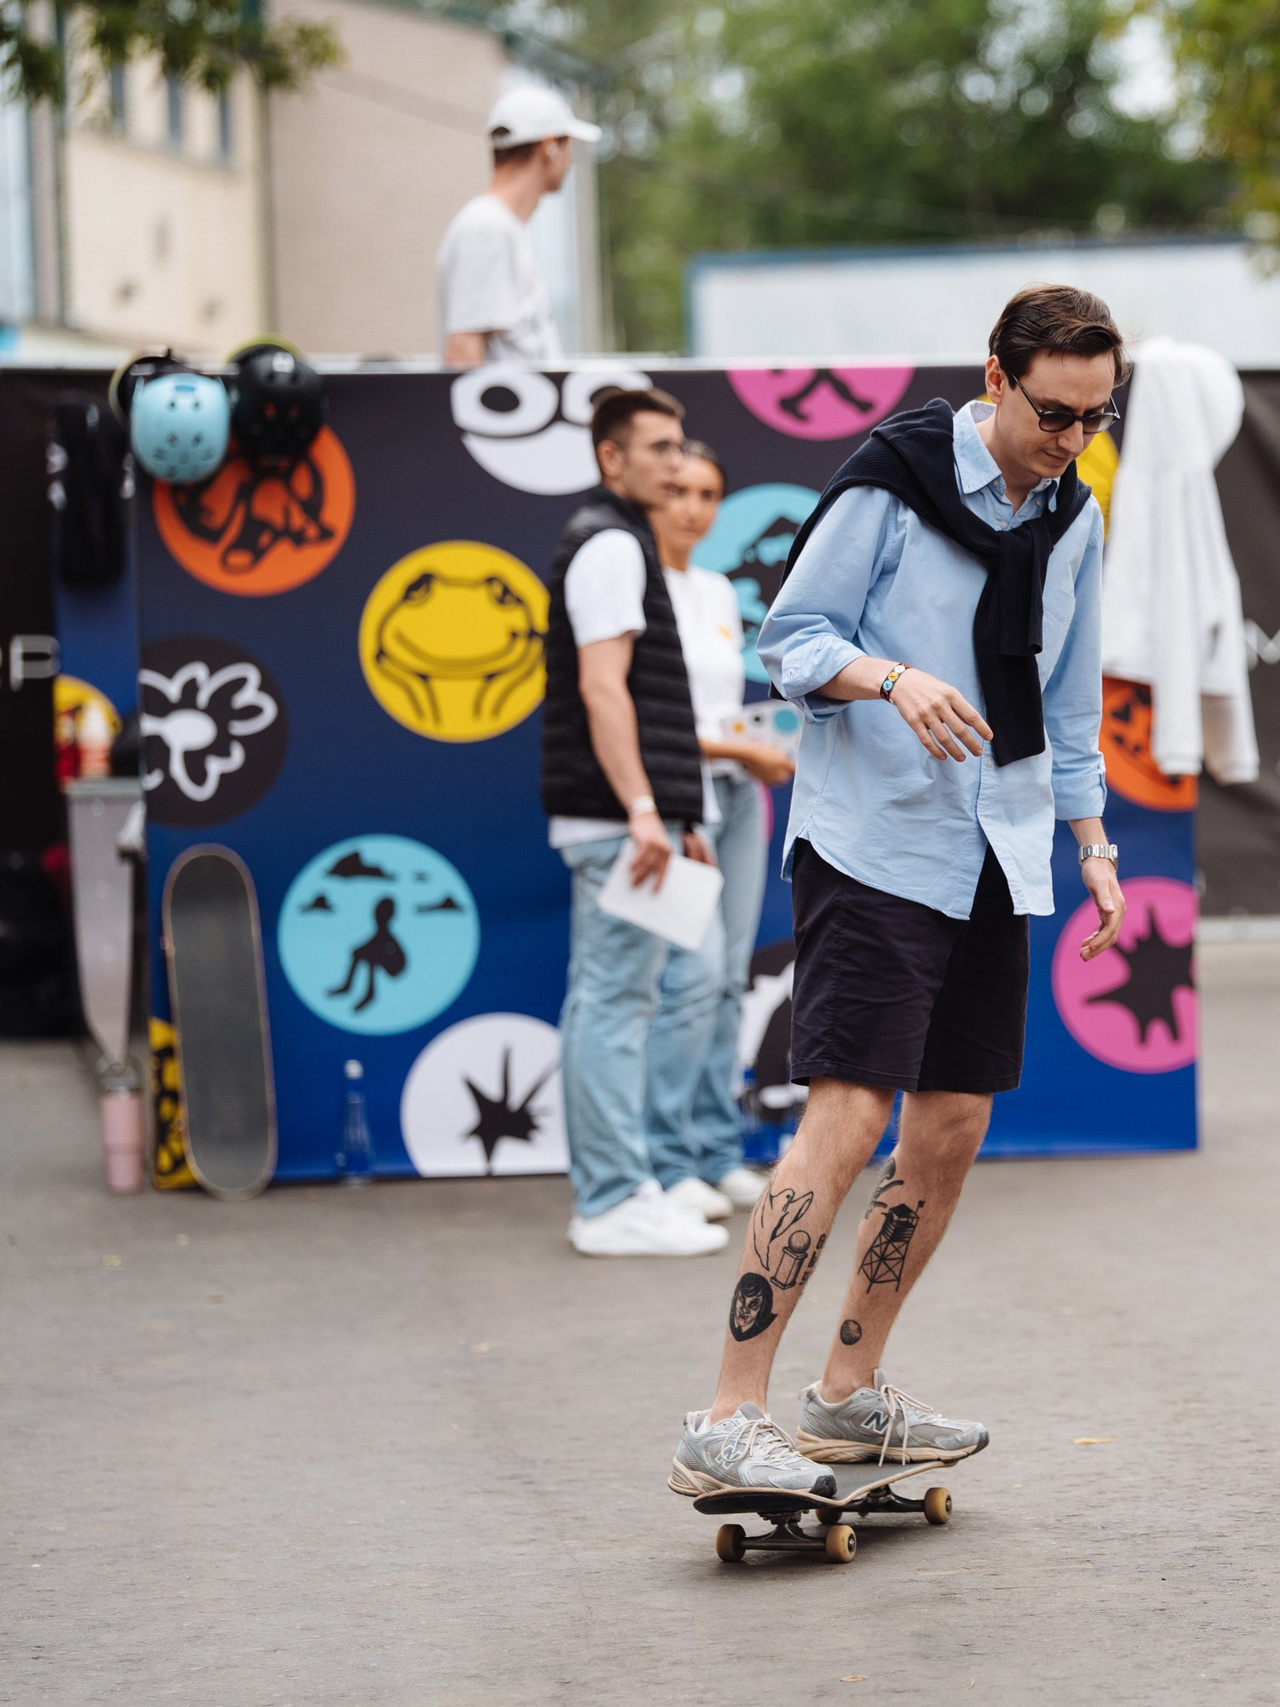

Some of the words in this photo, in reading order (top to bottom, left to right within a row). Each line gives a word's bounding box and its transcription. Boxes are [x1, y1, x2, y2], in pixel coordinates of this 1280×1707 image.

[0, 634, 61, 691] P
[860, 1409, 890, 1434] N
[715, 1444, 742, 1470] N
